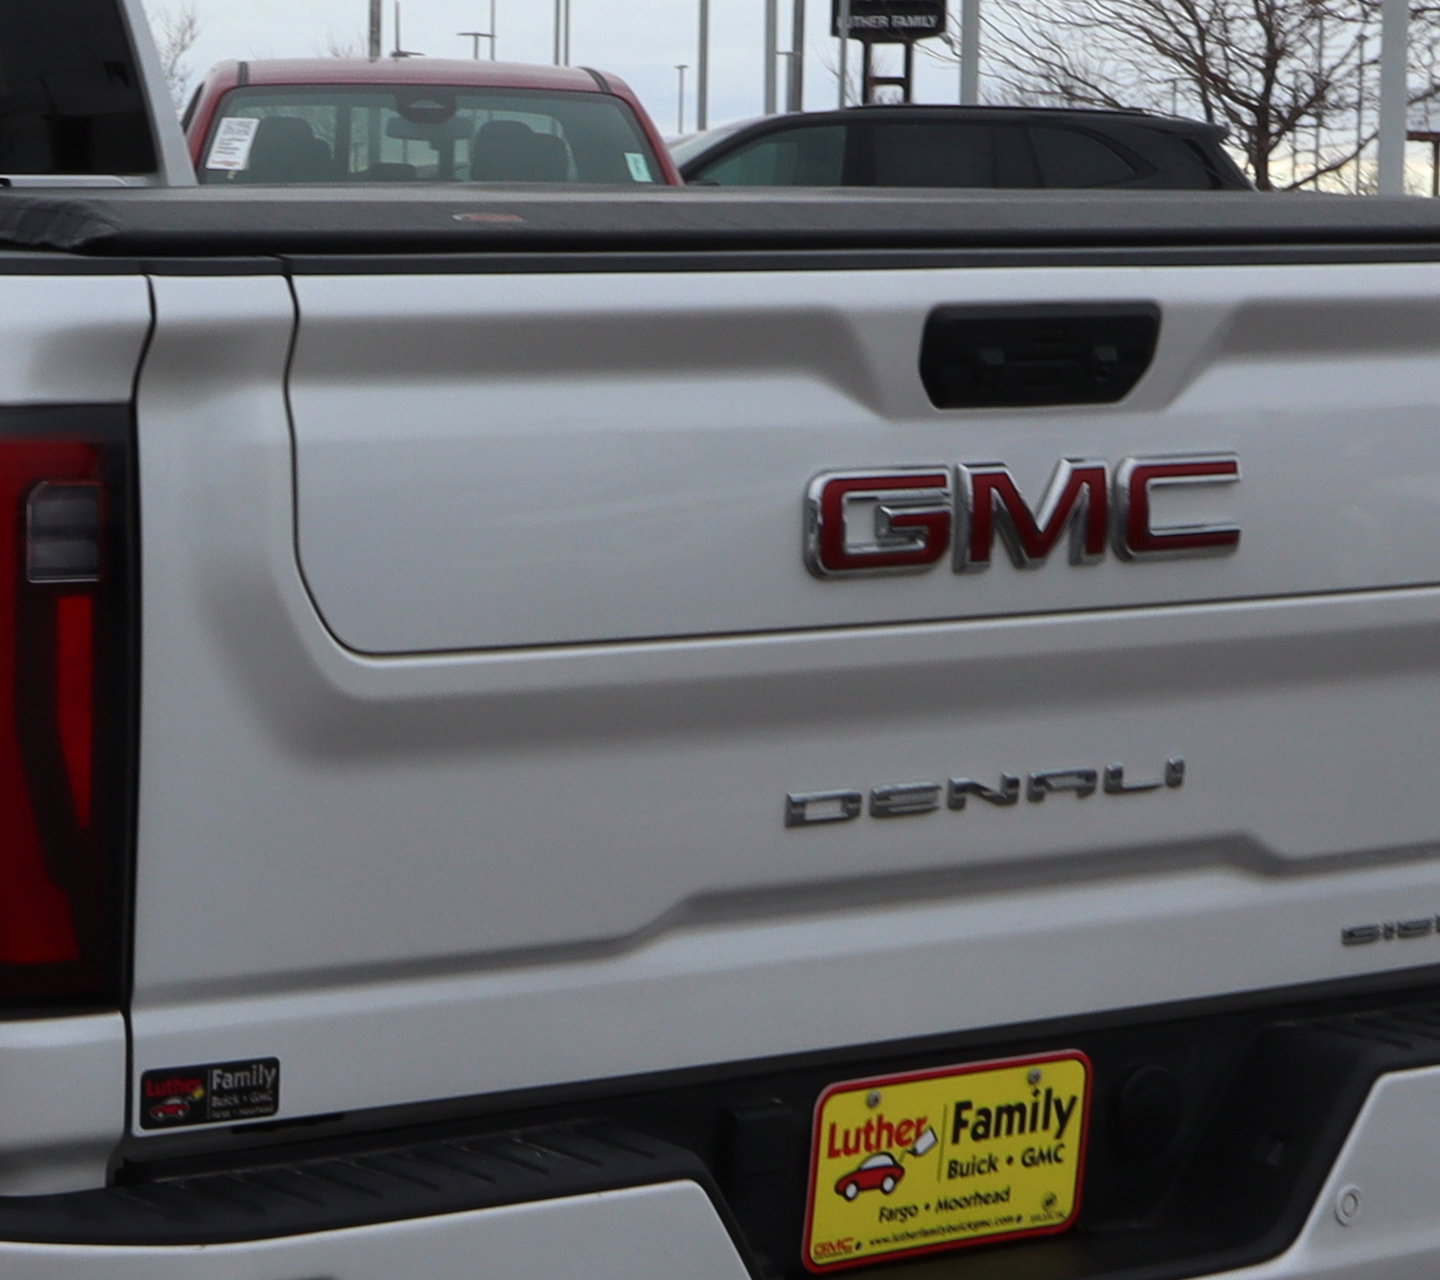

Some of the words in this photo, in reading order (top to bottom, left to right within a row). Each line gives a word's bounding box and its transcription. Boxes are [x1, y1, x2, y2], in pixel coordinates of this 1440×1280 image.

[803, 451, 1242, 580] GMC
[784, 757, 1185, 828] DENALI
[145, 1076, 203, 1097] Luther
[212, 1063, 276, 1090] Family
[827, 1115, 928, 1159] Luther
[951, 1088, 1077, 1145] Family
[947, 1153, 998, 1180] Buick
[1021, 1144, 1066, 1168] GMC
[878, 1203, 919, 1224] Fargo
[934, 1187, 1011, 1215] Moorhead
